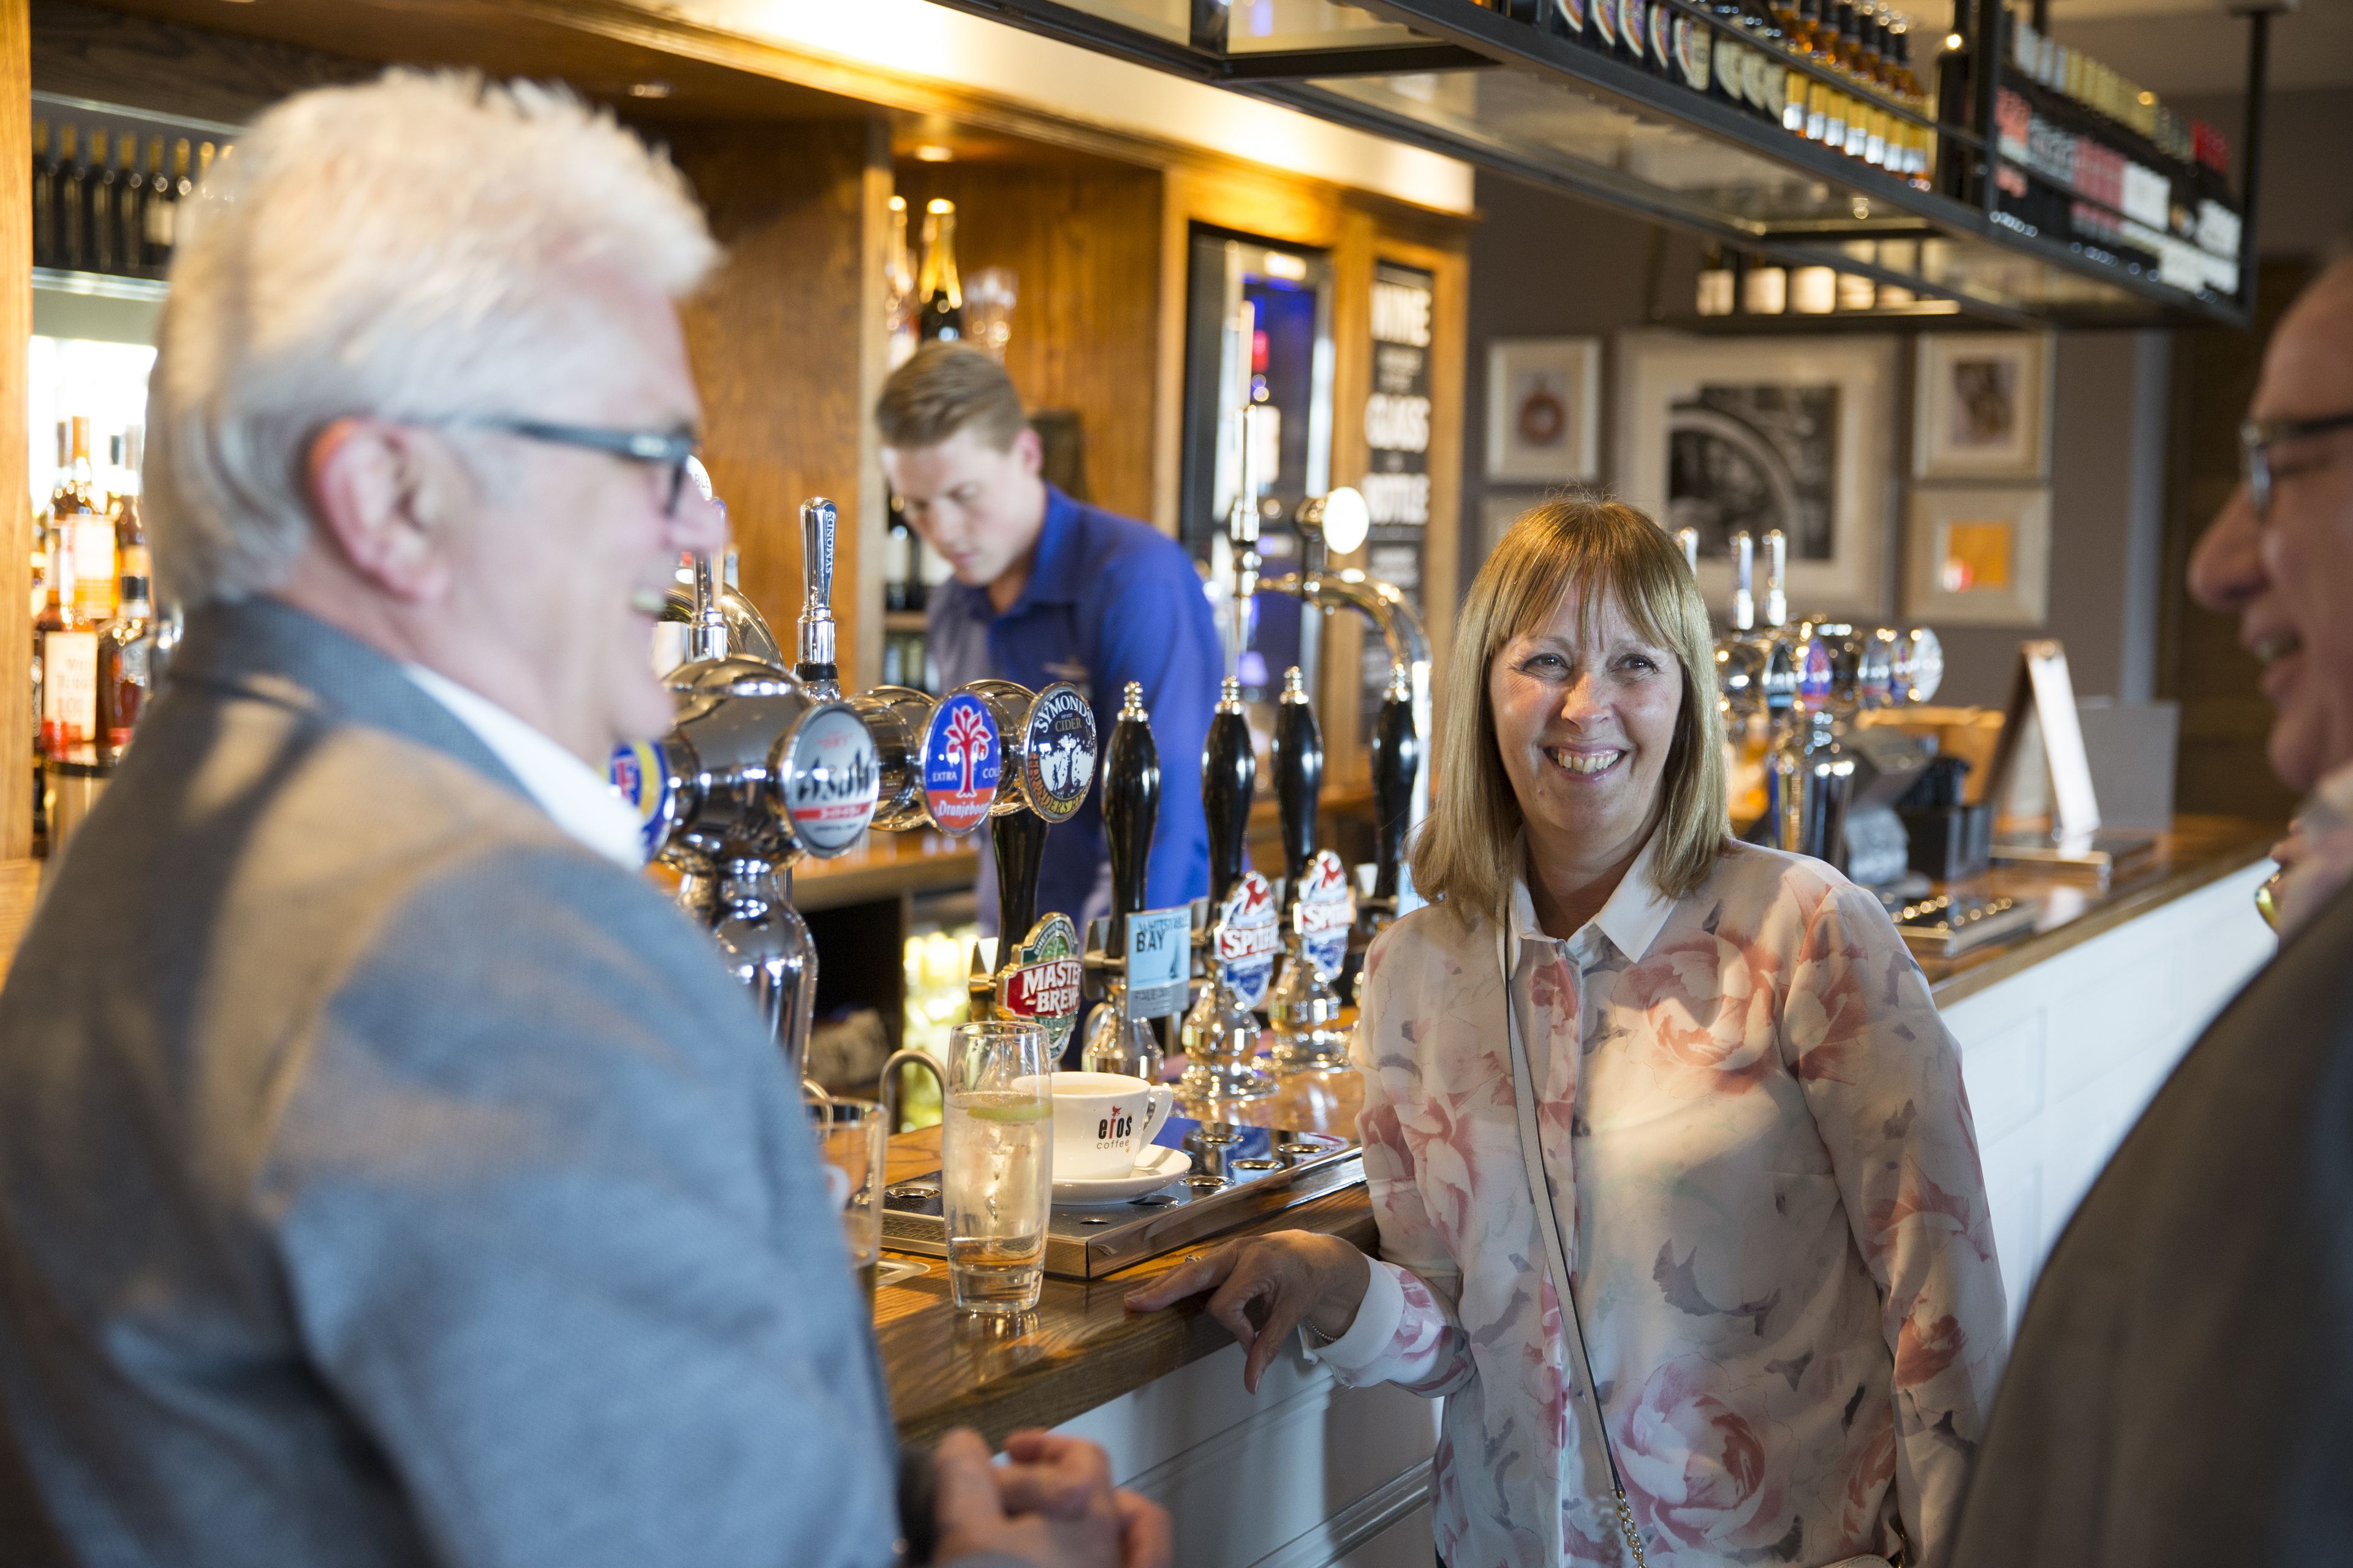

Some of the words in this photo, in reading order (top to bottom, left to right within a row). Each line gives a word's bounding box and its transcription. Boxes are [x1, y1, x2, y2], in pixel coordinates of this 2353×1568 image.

[1034, 695, 1091, 733] SYMONDS
[1055, 718, 1082, 732] CIDER
[932, 771, 958, 782] EXTRA
[1137, 930, 1165, 952] BAY
[1020, 961, 1082, 999] MASTE
[1098, 1115, 1132, 1139] eros
[1096, 1139, 1129, 1149] coffee
